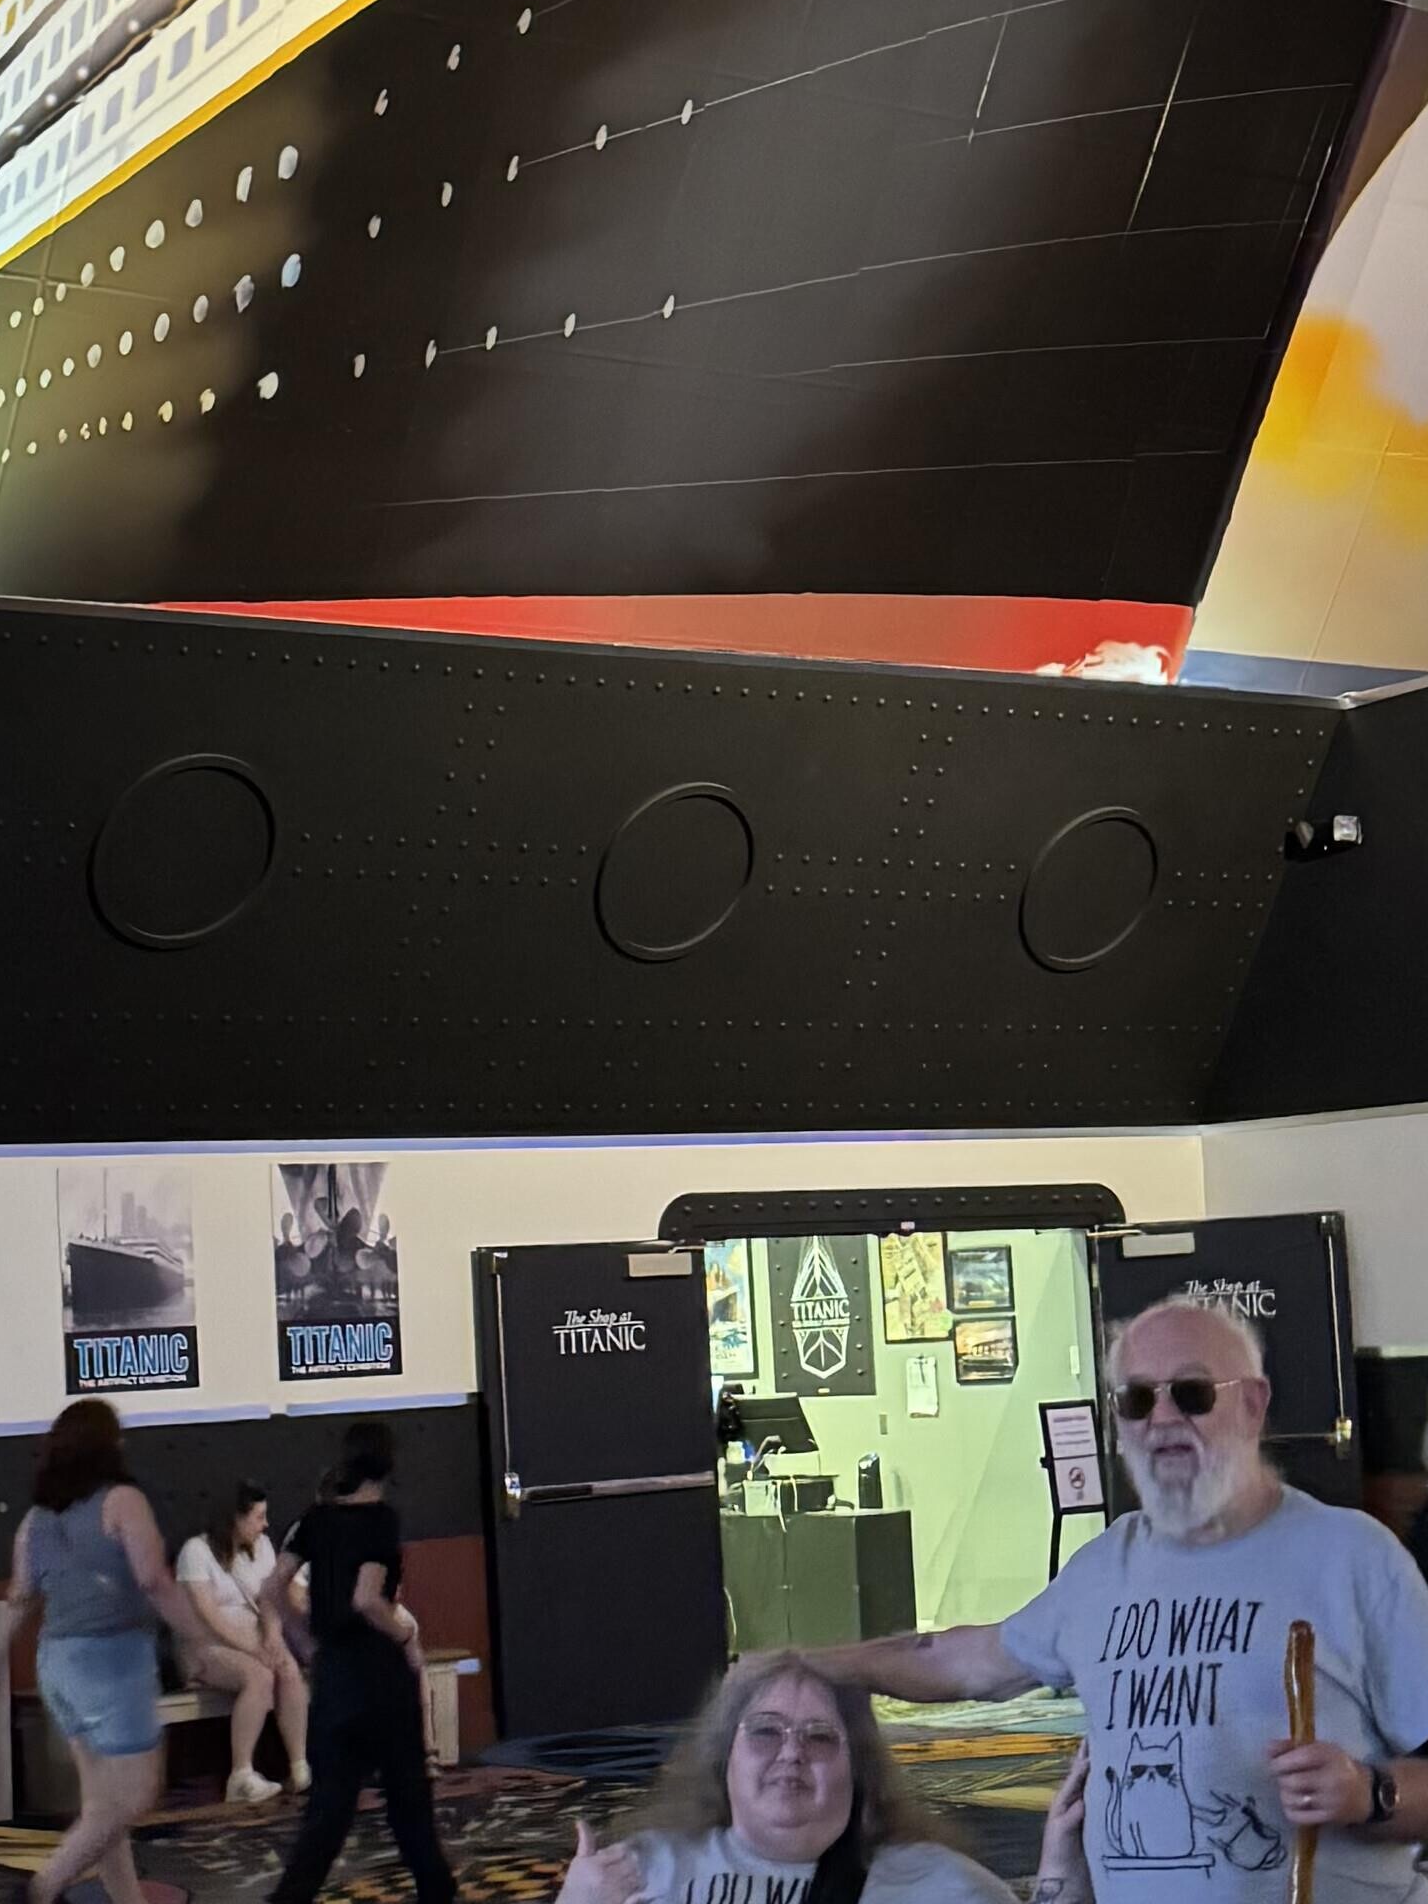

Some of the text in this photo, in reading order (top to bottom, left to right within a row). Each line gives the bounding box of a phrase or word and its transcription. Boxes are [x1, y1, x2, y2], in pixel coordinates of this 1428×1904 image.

[564, 1309, 587, 1326] The
[588, 1308, 618, 1328] Shop
[790, 1299, 851, 1321] TITANIC
[73, 1333, 189, 1379] TITANIC
[286, 1322, 394, 1366] TITANIC
[553, 1325, 646, 1355] TITANIC
[1097, 1595, 1264, 1663] I DO WHAT
[1105, 1661, 1223, 1730] I WANT
